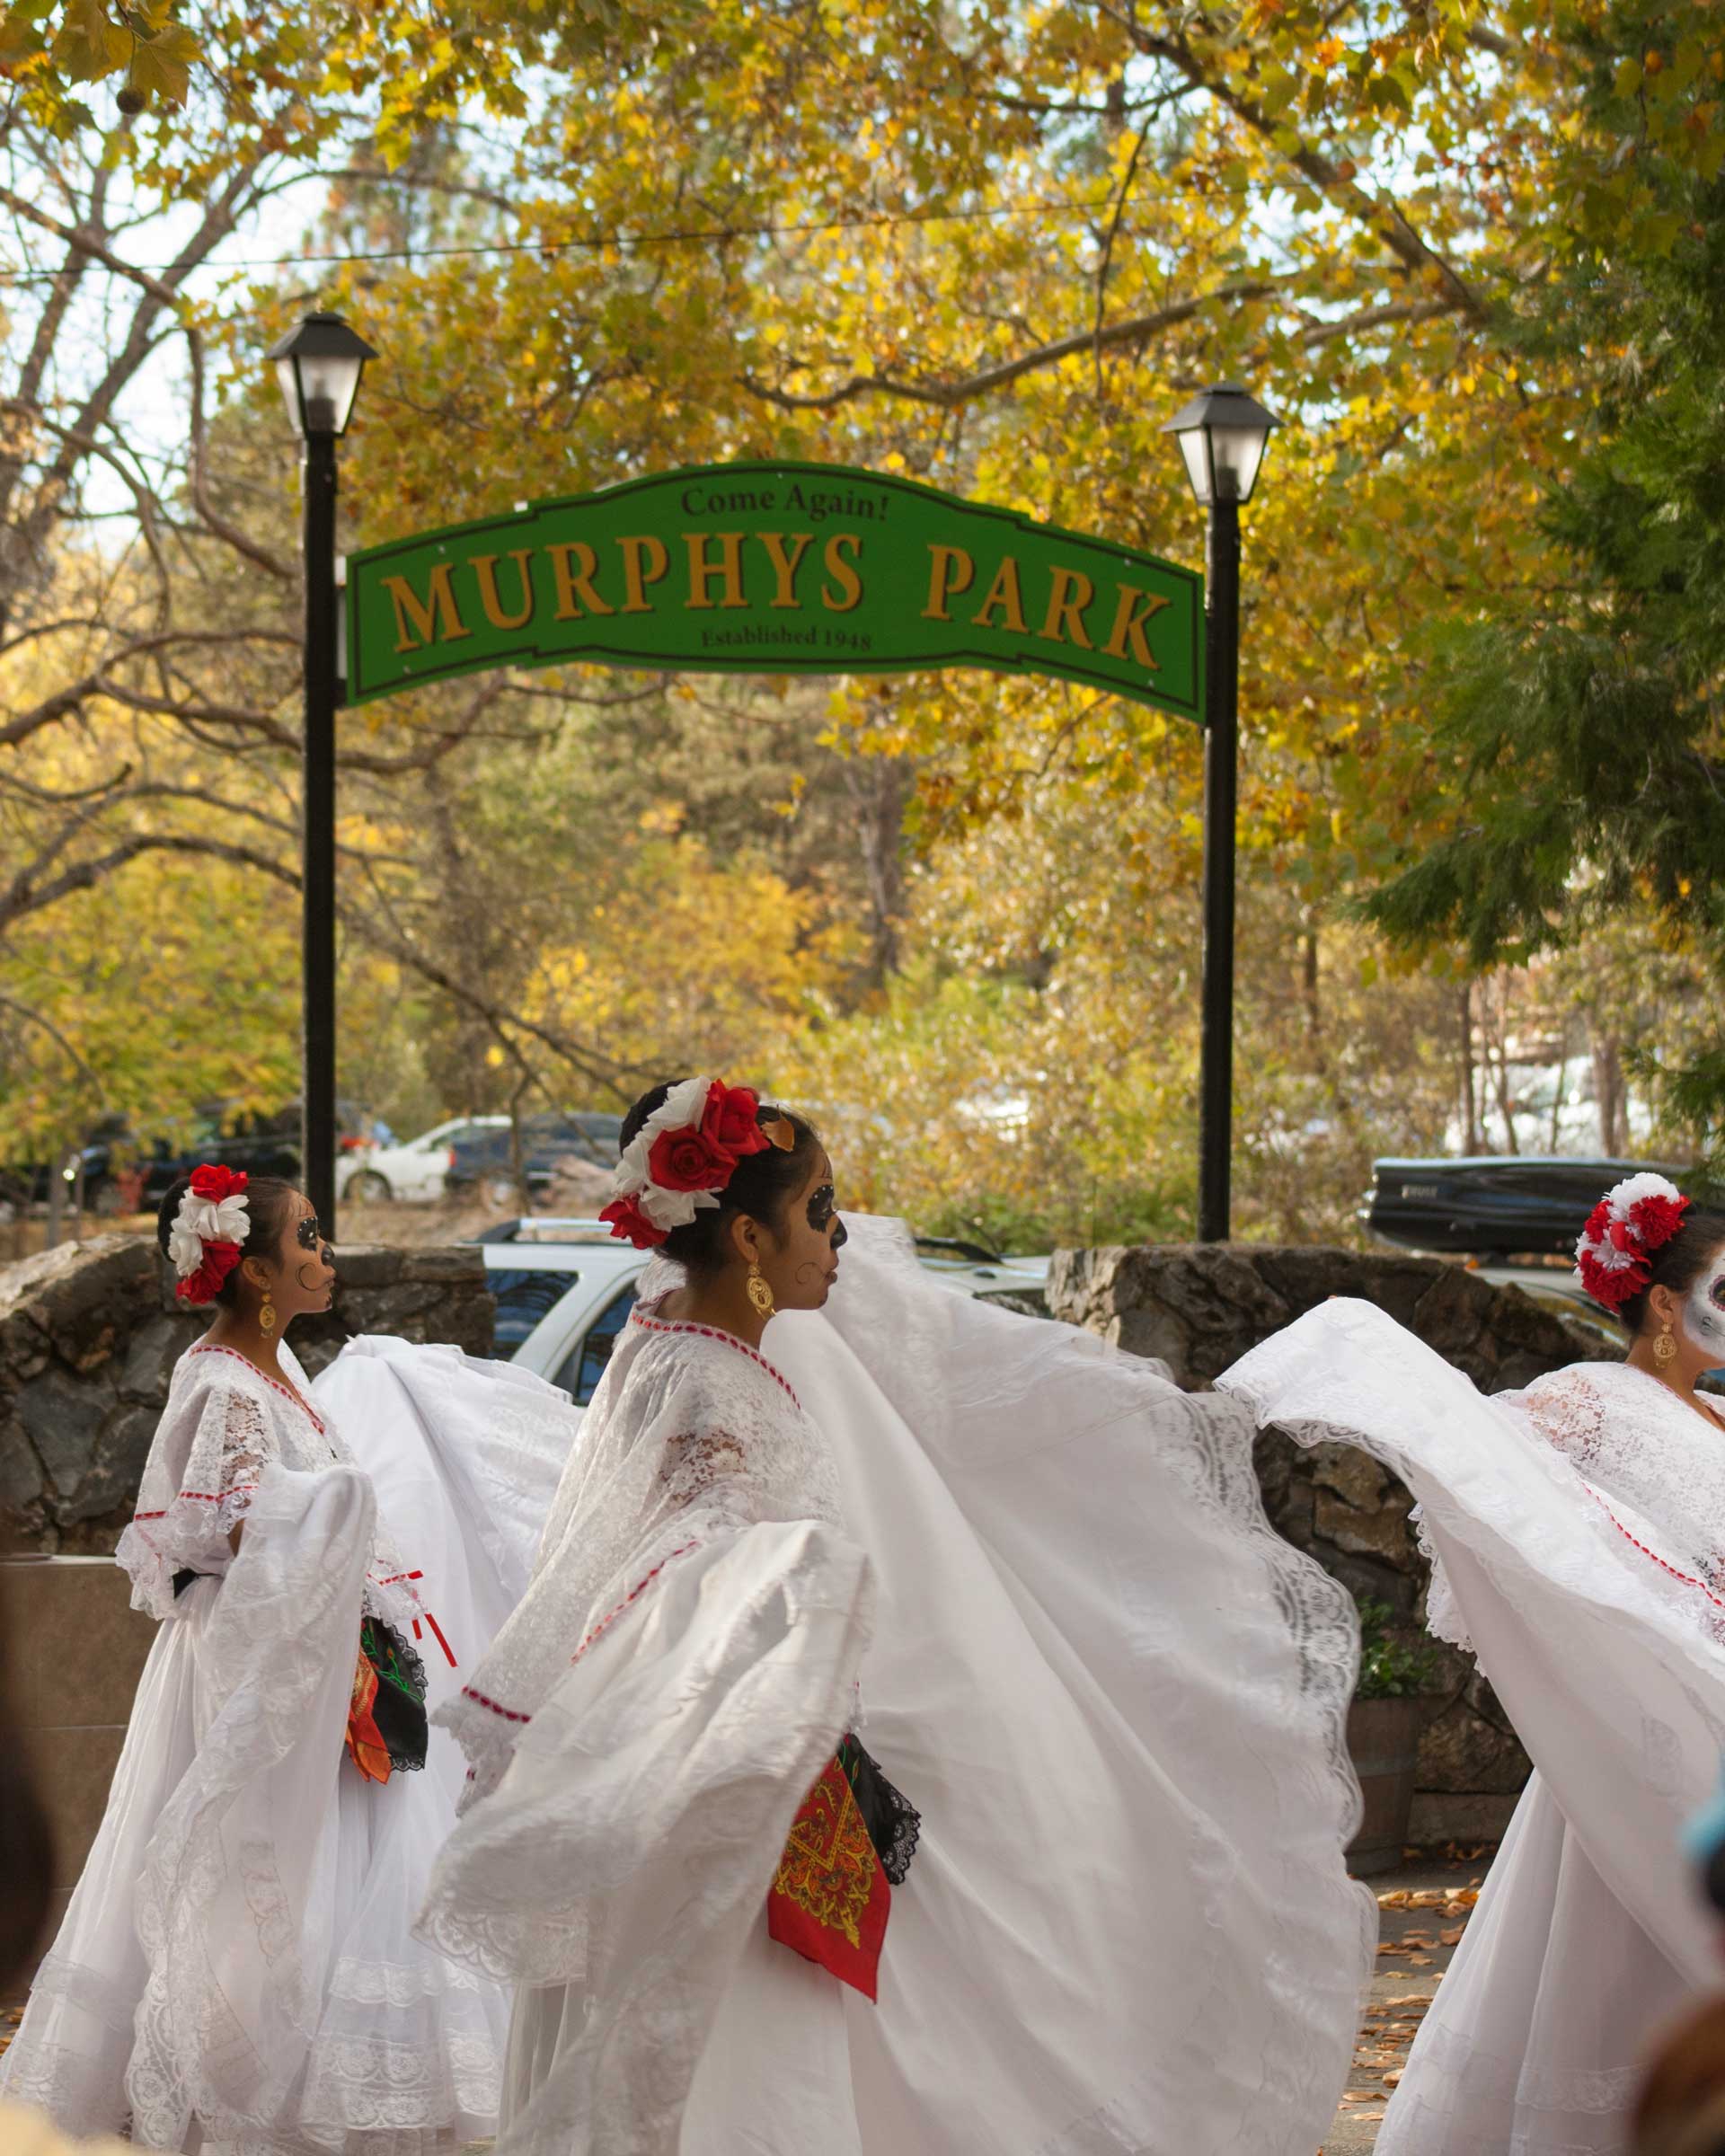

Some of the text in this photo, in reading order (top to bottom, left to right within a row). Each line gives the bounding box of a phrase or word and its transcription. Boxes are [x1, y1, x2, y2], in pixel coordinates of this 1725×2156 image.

[681, 483, 889, 522] Come Again!
[380, 532, 1172, 671] MURPHYS PARK
[701, 624, 871, 652] Established 1948
